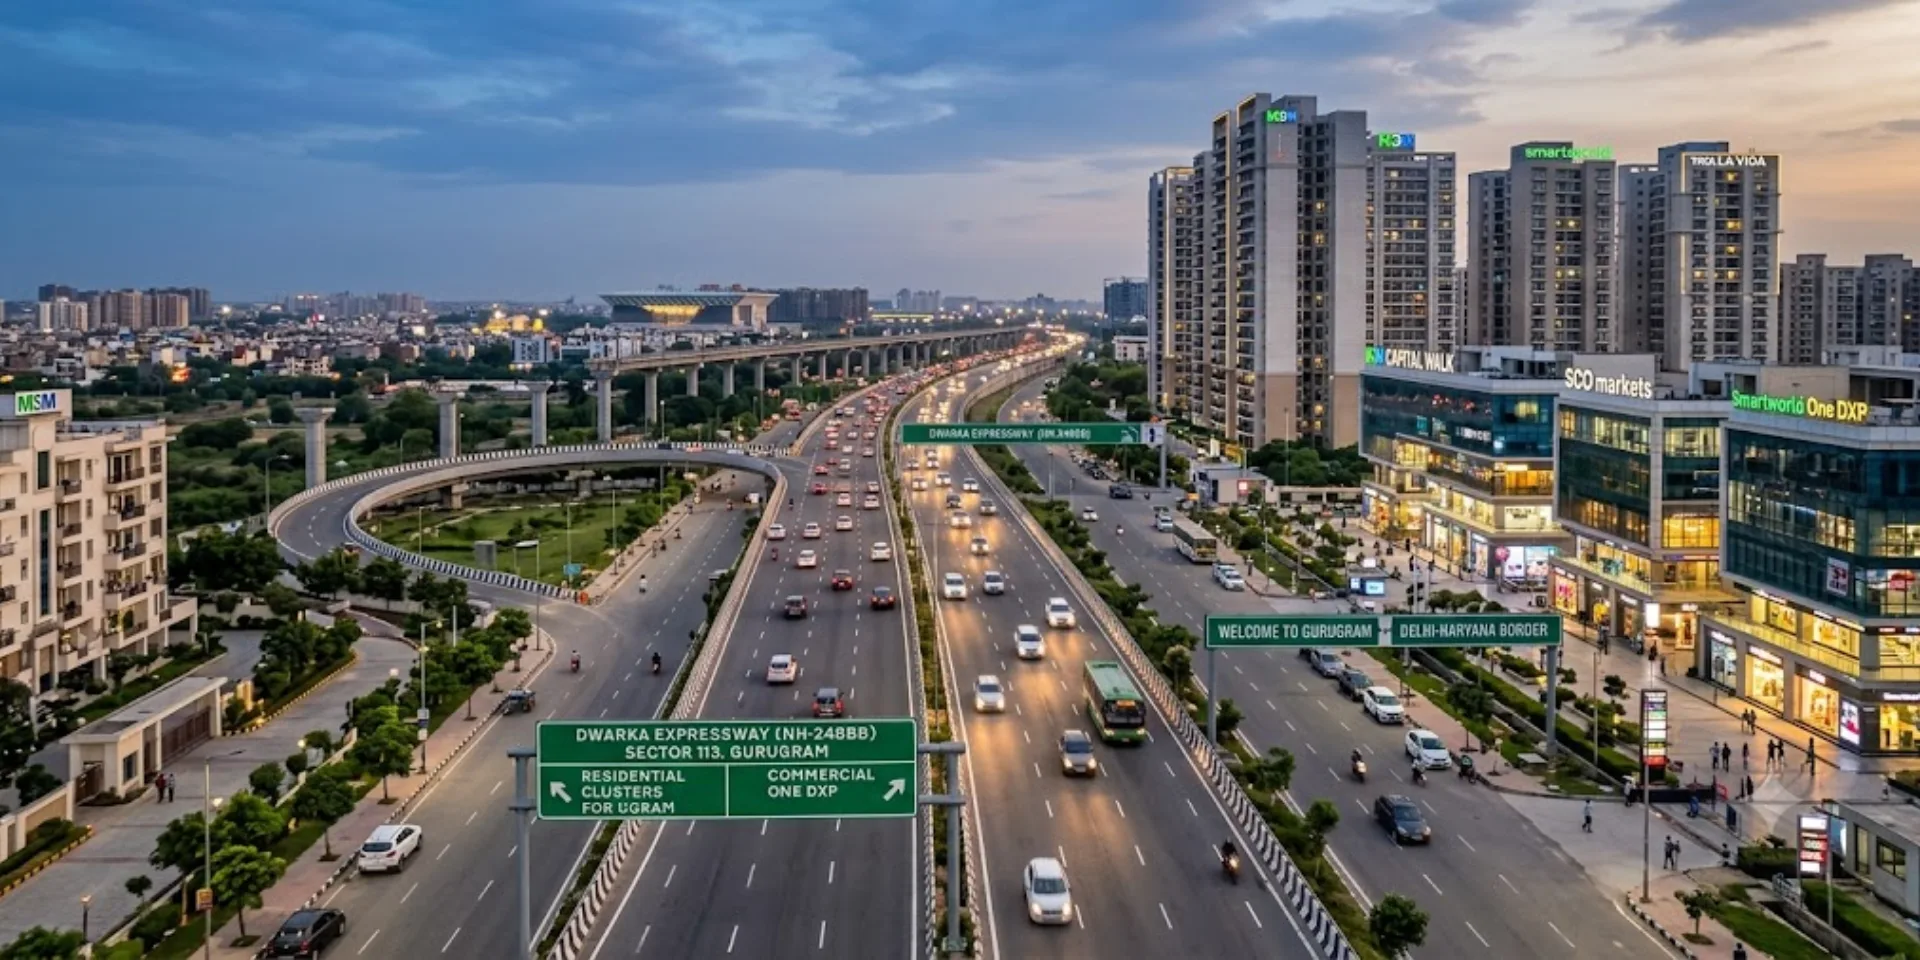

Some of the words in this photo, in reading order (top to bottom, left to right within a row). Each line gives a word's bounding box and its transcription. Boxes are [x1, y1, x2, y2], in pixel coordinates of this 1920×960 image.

[1424, 352, 1454, 373] WALK
[1565, 367, 1593, 392] SCO
[1595, 374, 1653, 399] markets
[18, 392, 56, 412] MSM
[1732, 390, 1805, 415] Smartworld
[1807, 397, 1835, 418] One
[1836, 400, 1868, 422] DXP
[1218, 624, 1279, 639] WELCOME
[1282, 624, 1299, 639] TO
[1301, 624, 1373, 639] GURUGRAM
[1399, 623, 1496, 638] DELHI-HARYANA
[1500, 623, 1549, 637] BORDER
[575, 728, 650, 742] DWARKA
[654, 727, 770, 741] EXPRESSWAY
[625, 745, 692, 759] SECTOR
[730, 744, 829, 759] GURUGRAM
[581, 769, 686, 782] RESIDENTIAL
[767, 768, 875, 781] COMMERCIAL
[581, 785, 663, 798] CLUSTERS
[768, 785, 802, 798] ONE
[806, 785, 838, 797] DXP
[581, 802, 613, 814] FOR
